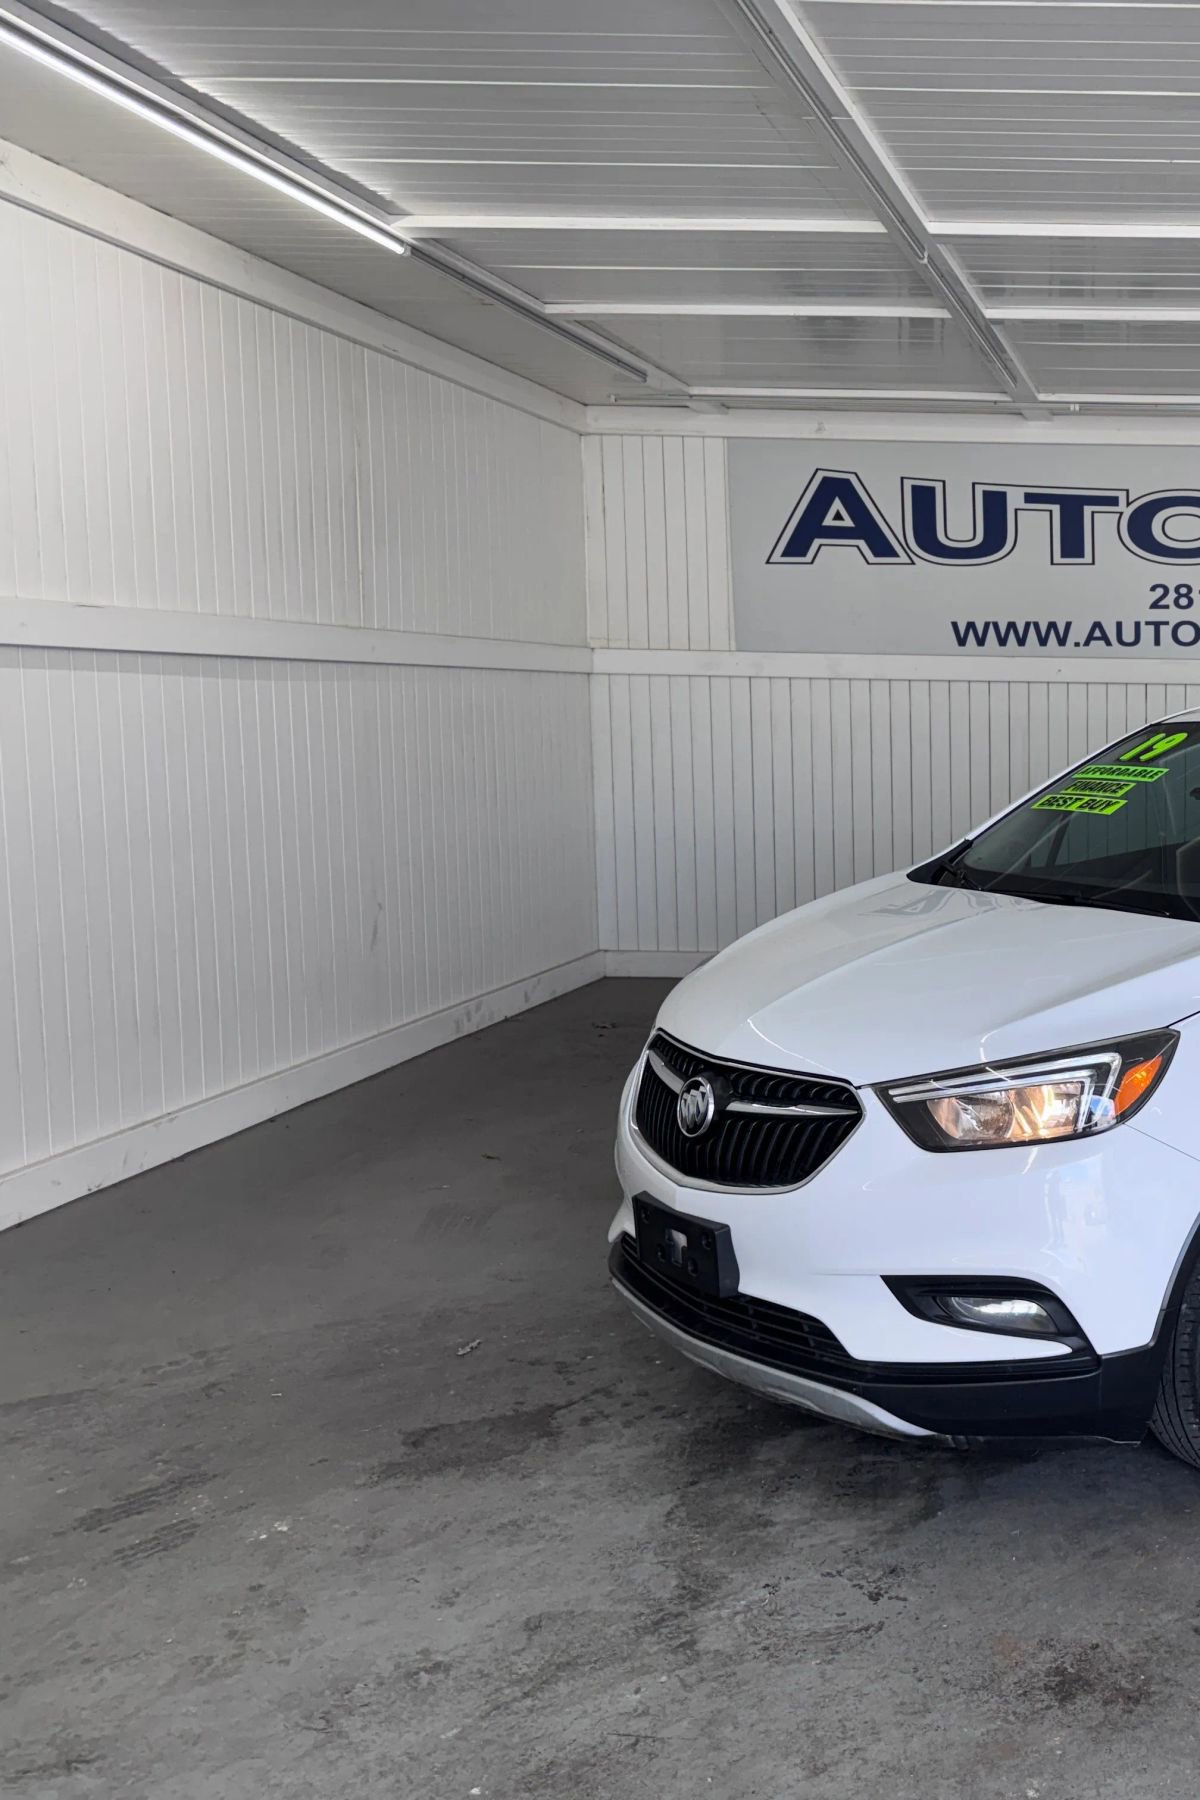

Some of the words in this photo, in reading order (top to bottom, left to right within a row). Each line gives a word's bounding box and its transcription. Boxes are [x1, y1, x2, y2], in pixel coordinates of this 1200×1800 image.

[1119, 732, 1188, 762] 19
[1077, 766, 1165, 779] AFFORDABLE
[1063, 780, 1131, 794] FINANCE
[1038, 796, 1084, 809] BEST
[1078, 798, 1117, 812] BUY
